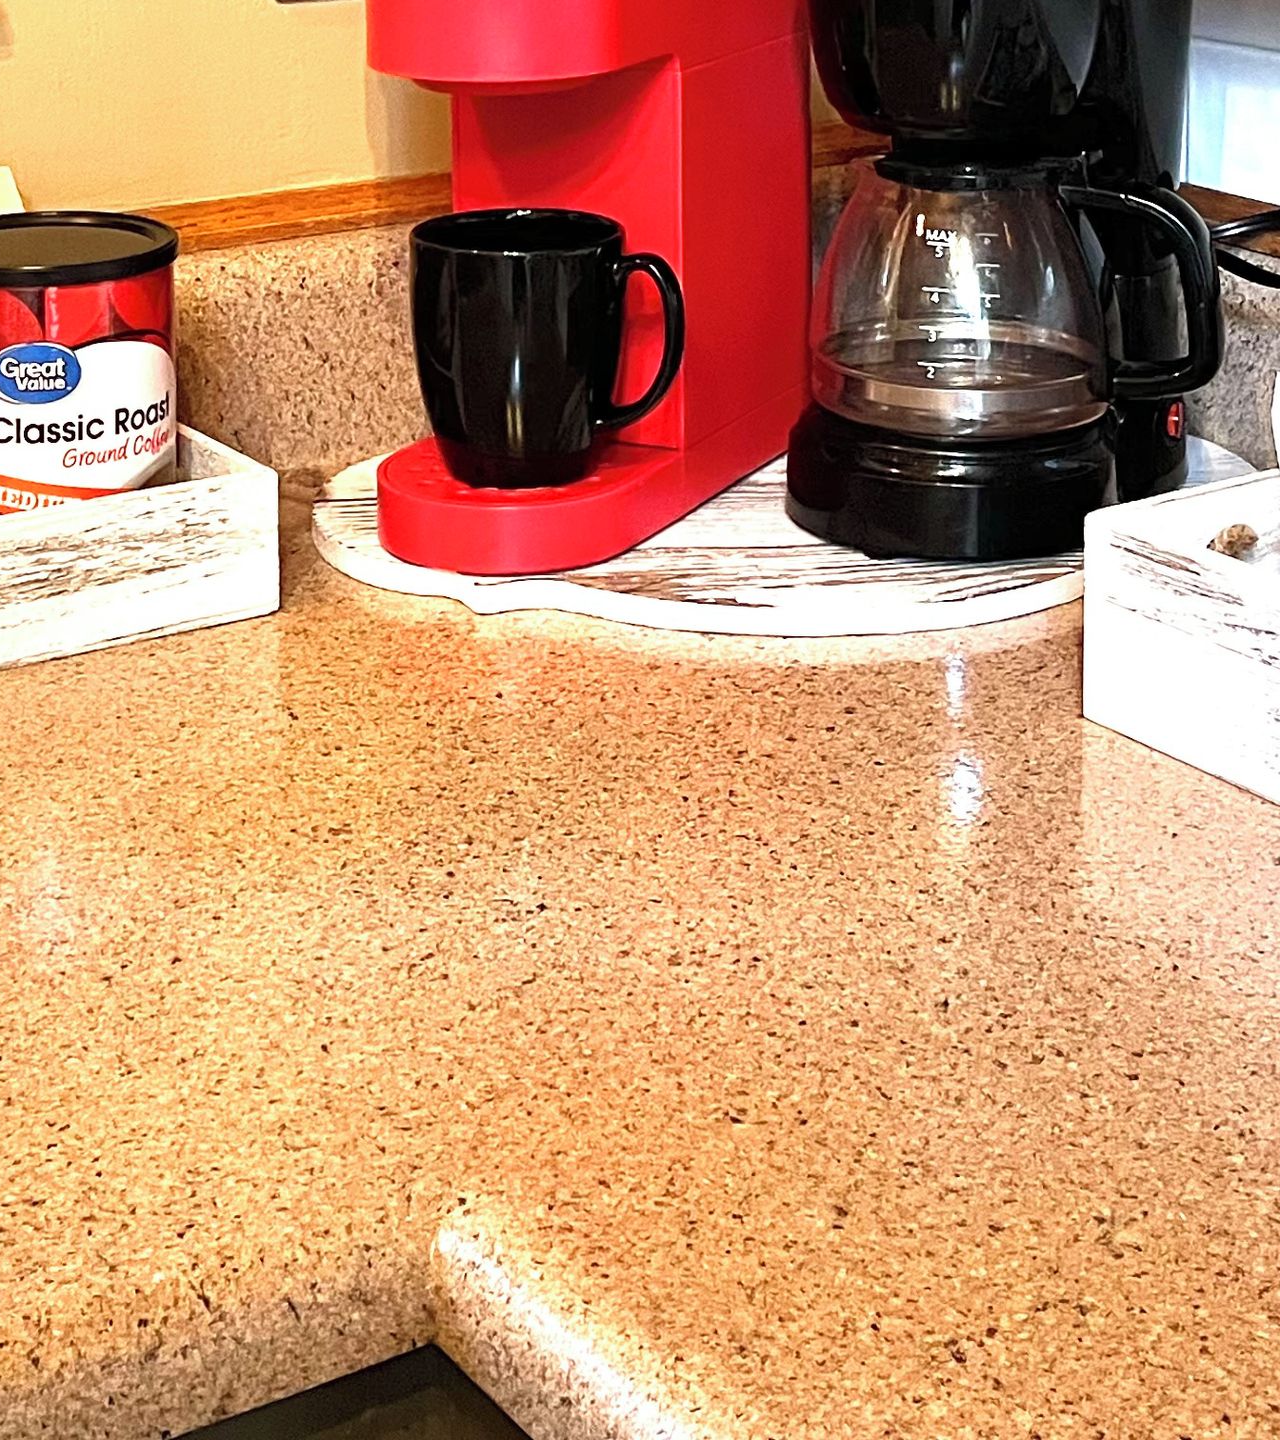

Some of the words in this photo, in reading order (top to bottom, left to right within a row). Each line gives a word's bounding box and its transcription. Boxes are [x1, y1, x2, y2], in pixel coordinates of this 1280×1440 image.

[925, 228, 958, 241] MAX
[934, 246, 945, 259] 5
[929, 291, 941, 304] 4
[927, 329, 938, 343] 3
[0, 356, 66, 378] Great
[926, 365, 936, 380] 2
[14, 376, 67, 391] Value
[114, 391, 170, 435] Roast
[62, 437, 130, 469] Ground
